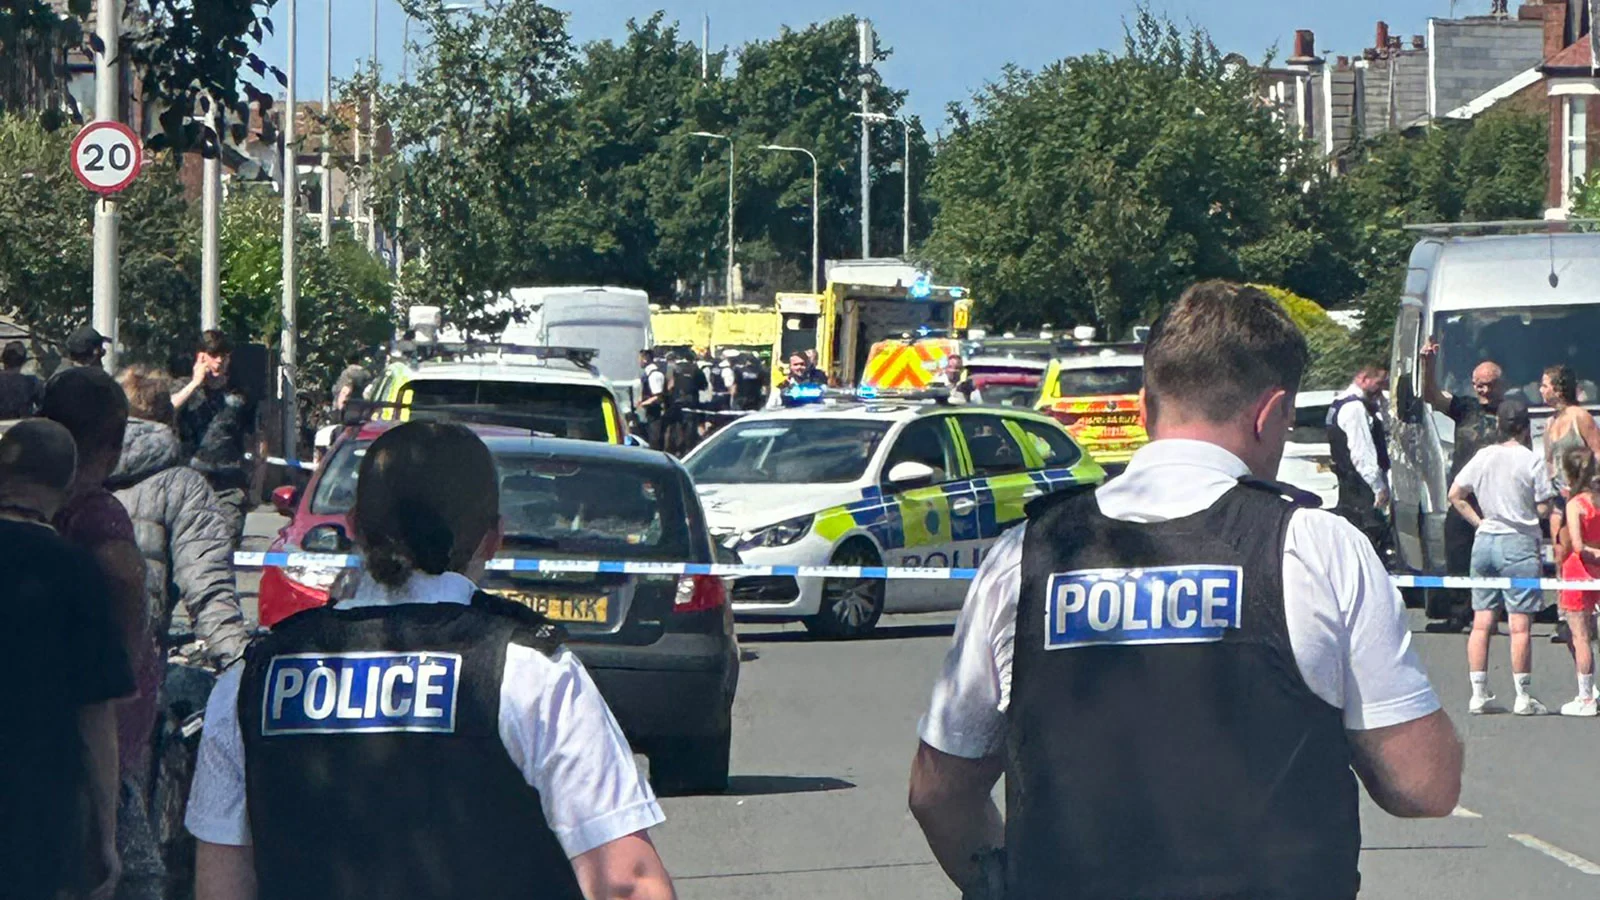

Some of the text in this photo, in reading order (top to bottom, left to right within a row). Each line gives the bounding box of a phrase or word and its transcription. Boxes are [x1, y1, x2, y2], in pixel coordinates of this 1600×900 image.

[83, 143, 131, 171] 20
[556, 597, 598, 619] TKK
[1056, 578, 1231, 634] POLICE
[273, 664, 448, 719] POLICE
